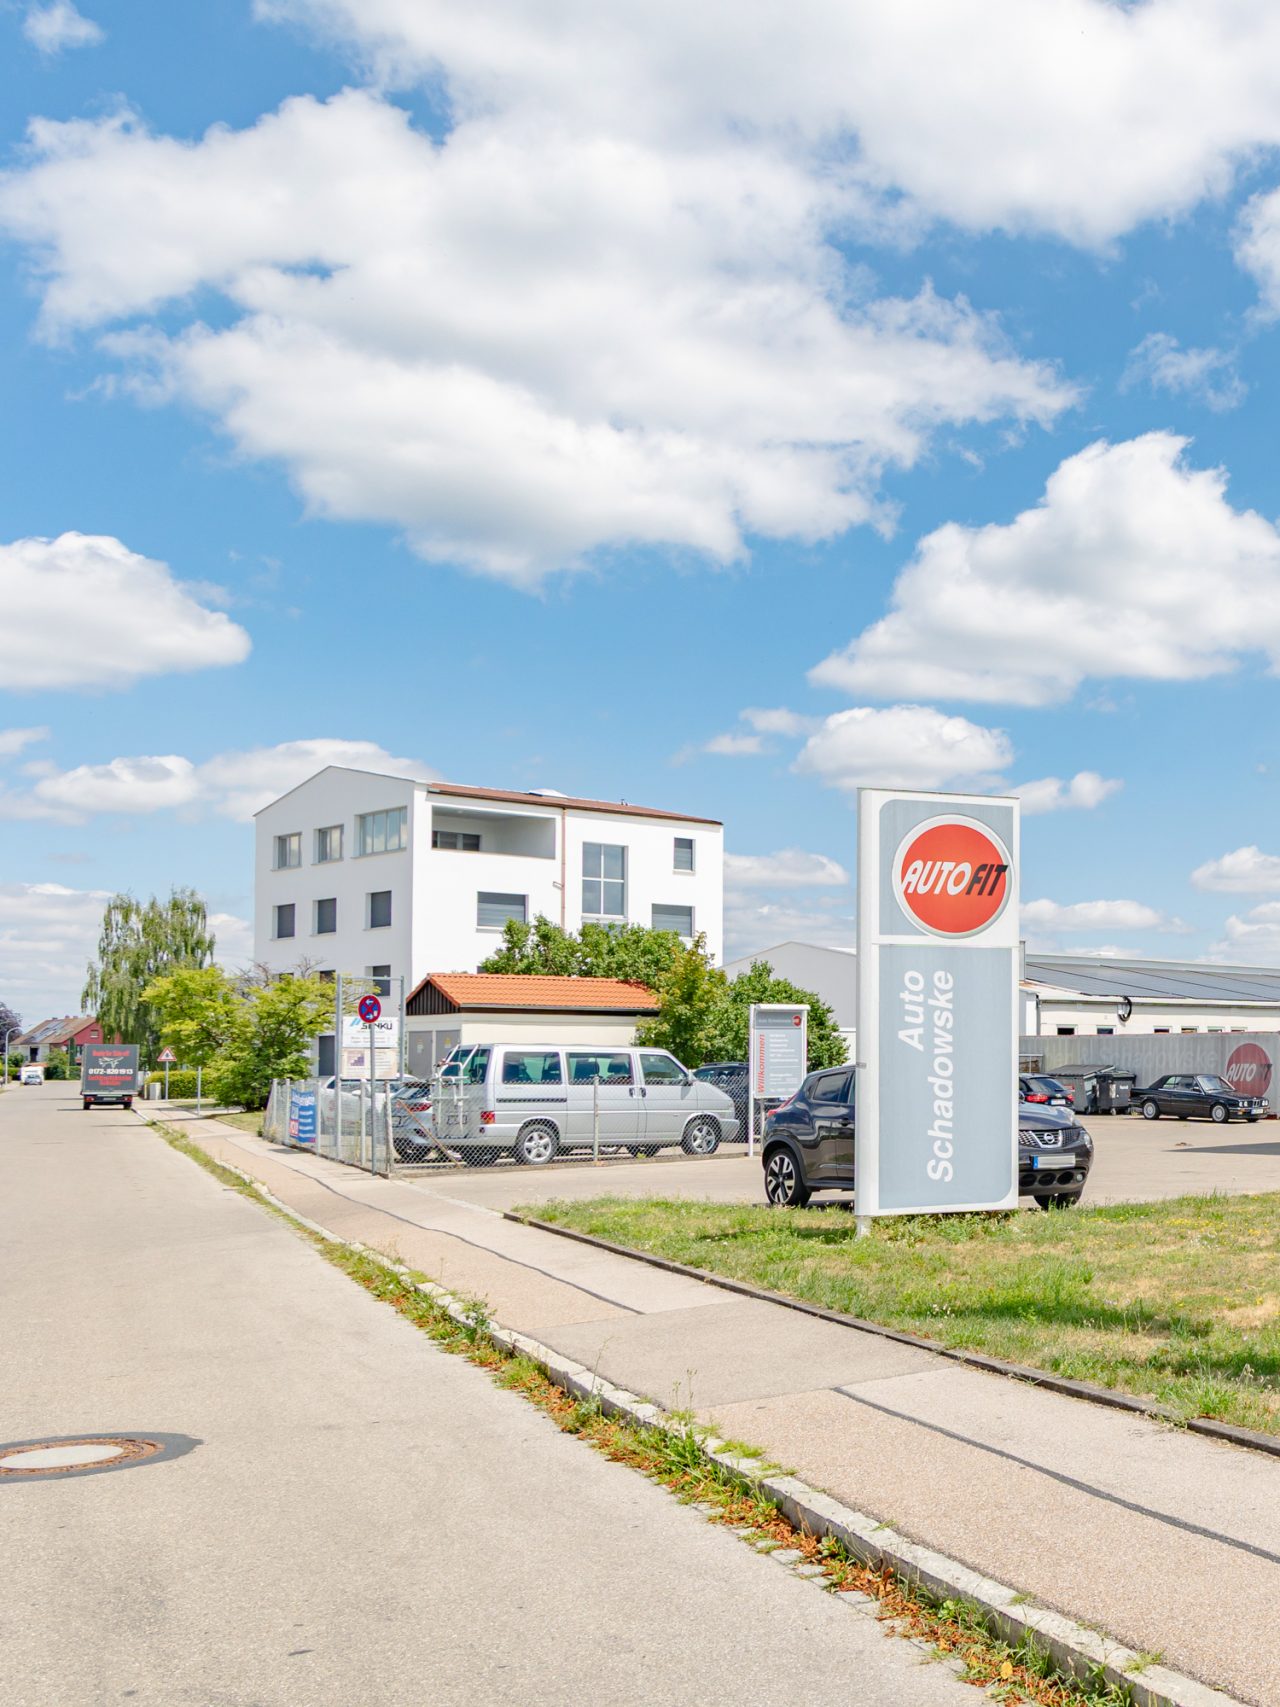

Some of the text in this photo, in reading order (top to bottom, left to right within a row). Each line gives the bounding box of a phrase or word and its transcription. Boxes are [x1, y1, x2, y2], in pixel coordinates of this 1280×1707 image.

[898, 970, 925, 1051] Auto
[757, 1034, 765, 1093] Willkommen
[927, 971, 954, 1182] Schadowske
